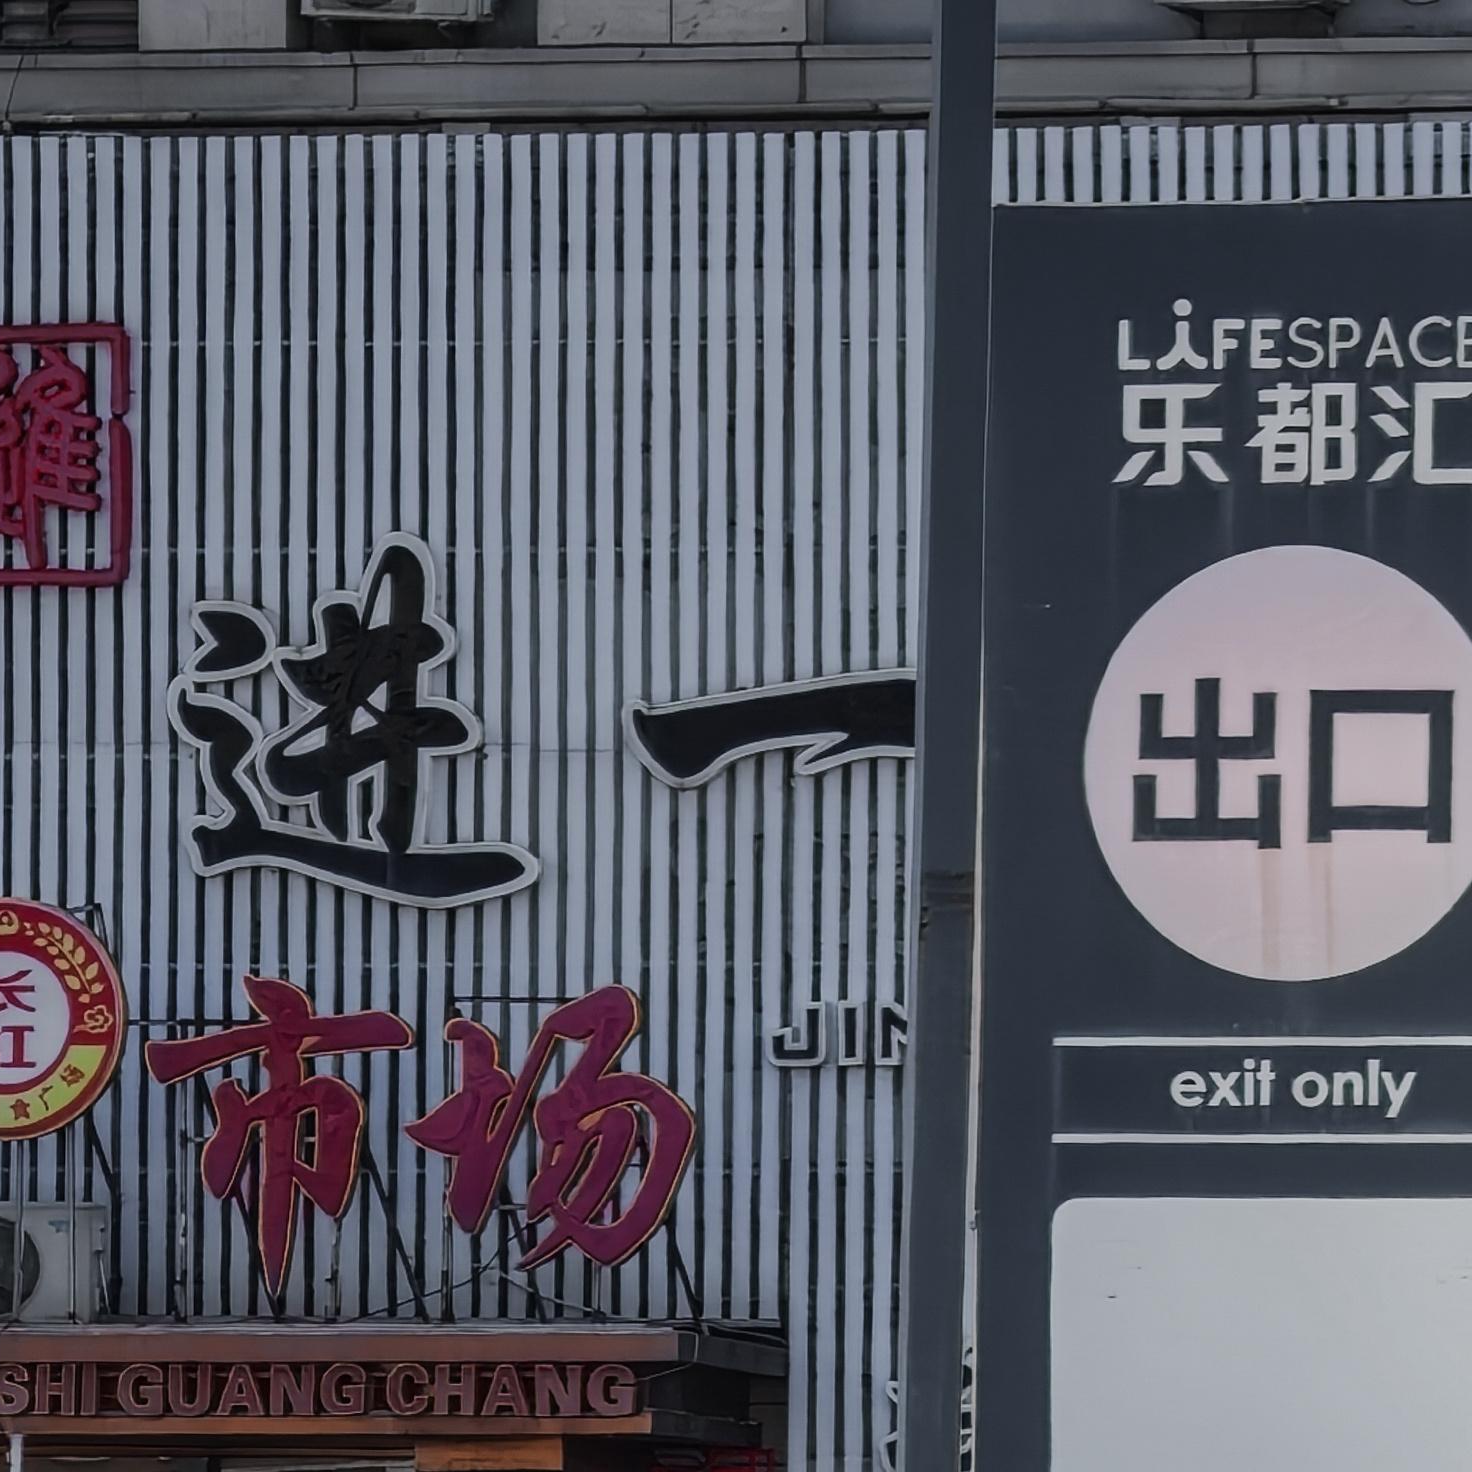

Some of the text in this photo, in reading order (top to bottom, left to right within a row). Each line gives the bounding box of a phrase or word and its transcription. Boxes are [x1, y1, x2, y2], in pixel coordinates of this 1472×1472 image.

[1131, 677, 1455, 850] 出口
[145, 973, 696, 1298] 市场
[1170, 1058, 1418, 1118] exit only
[116, 1362, 366, 1417] GUANG
[387, 1362, 638, 1418] CHANG
